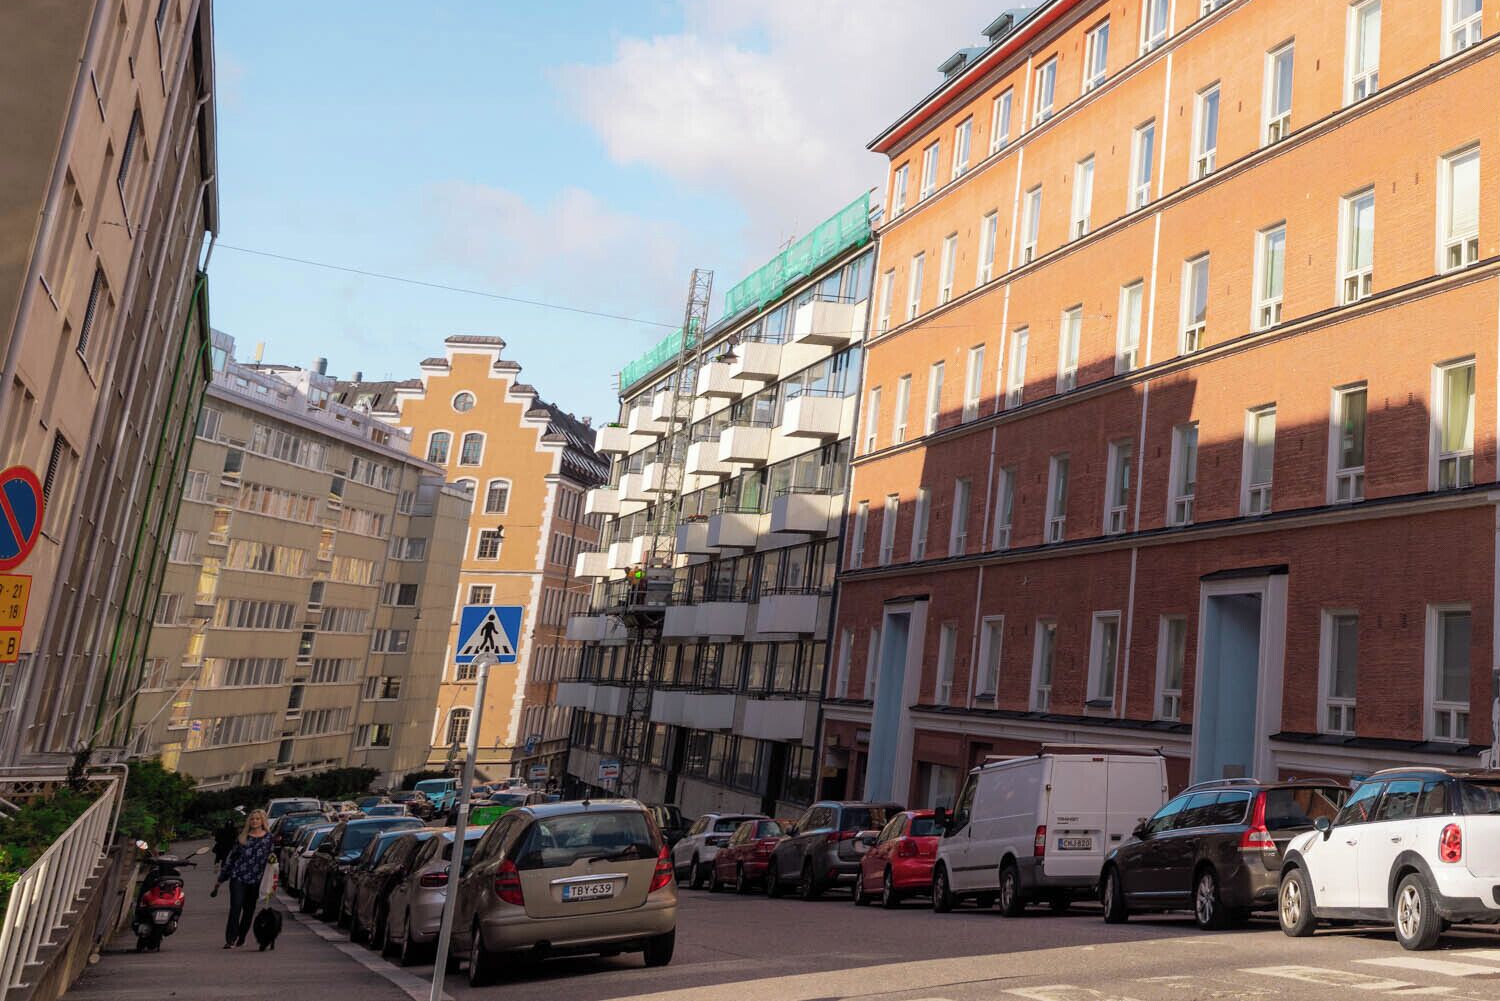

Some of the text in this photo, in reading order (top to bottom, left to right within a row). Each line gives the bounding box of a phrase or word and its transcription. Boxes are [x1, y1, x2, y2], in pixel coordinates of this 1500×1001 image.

[12, 584, 22, 598] 21
[7, 637, 16, 655] B
[571, 884, 611, 896] TBY-639
